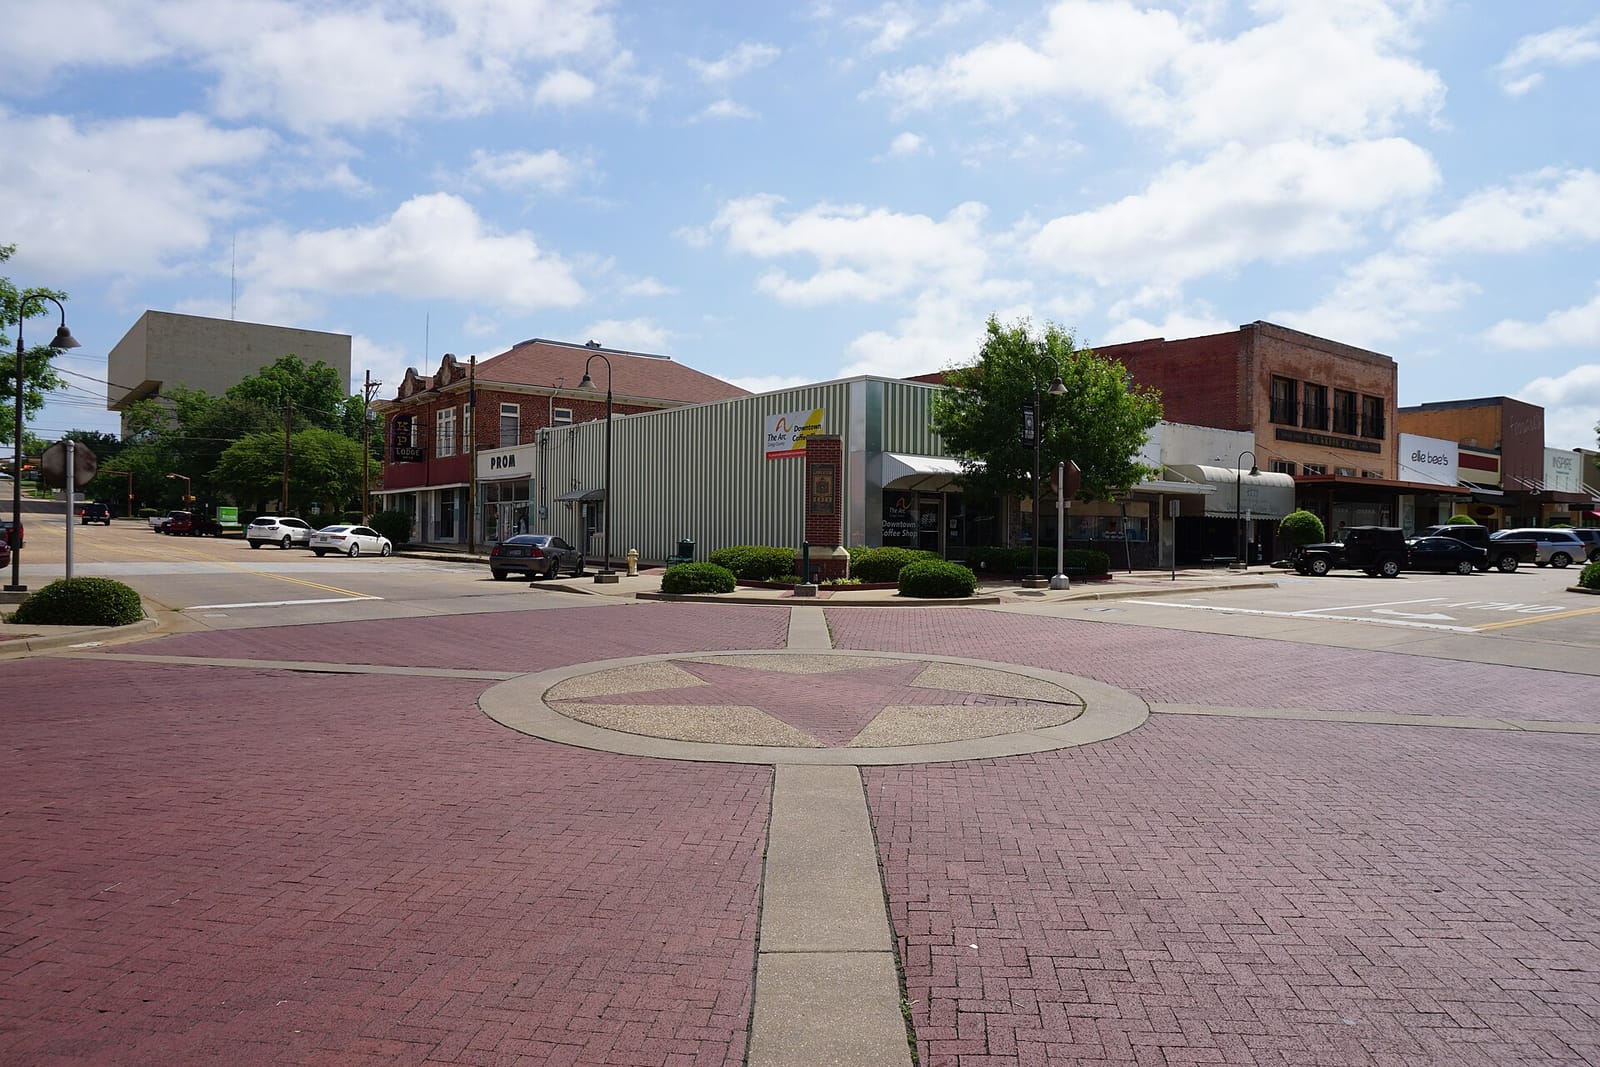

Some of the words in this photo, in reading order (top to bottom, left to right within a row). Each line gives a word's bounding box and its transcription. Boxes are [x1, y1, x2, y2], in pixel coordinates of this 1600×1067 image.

[397, 421, 408, 431] K
[794, 424, 822, 432] Downtown
[397, 436, 407, 445] P
[767, 433, 777, 441] The
[396, 448, 421, 456] LODGE
[490, 454, 515, 470] PROM
[1427, 451, 1448, 466] bee's
[881, 520, 916, 528] Downtown
[902, 530, 918, 538] Shop
